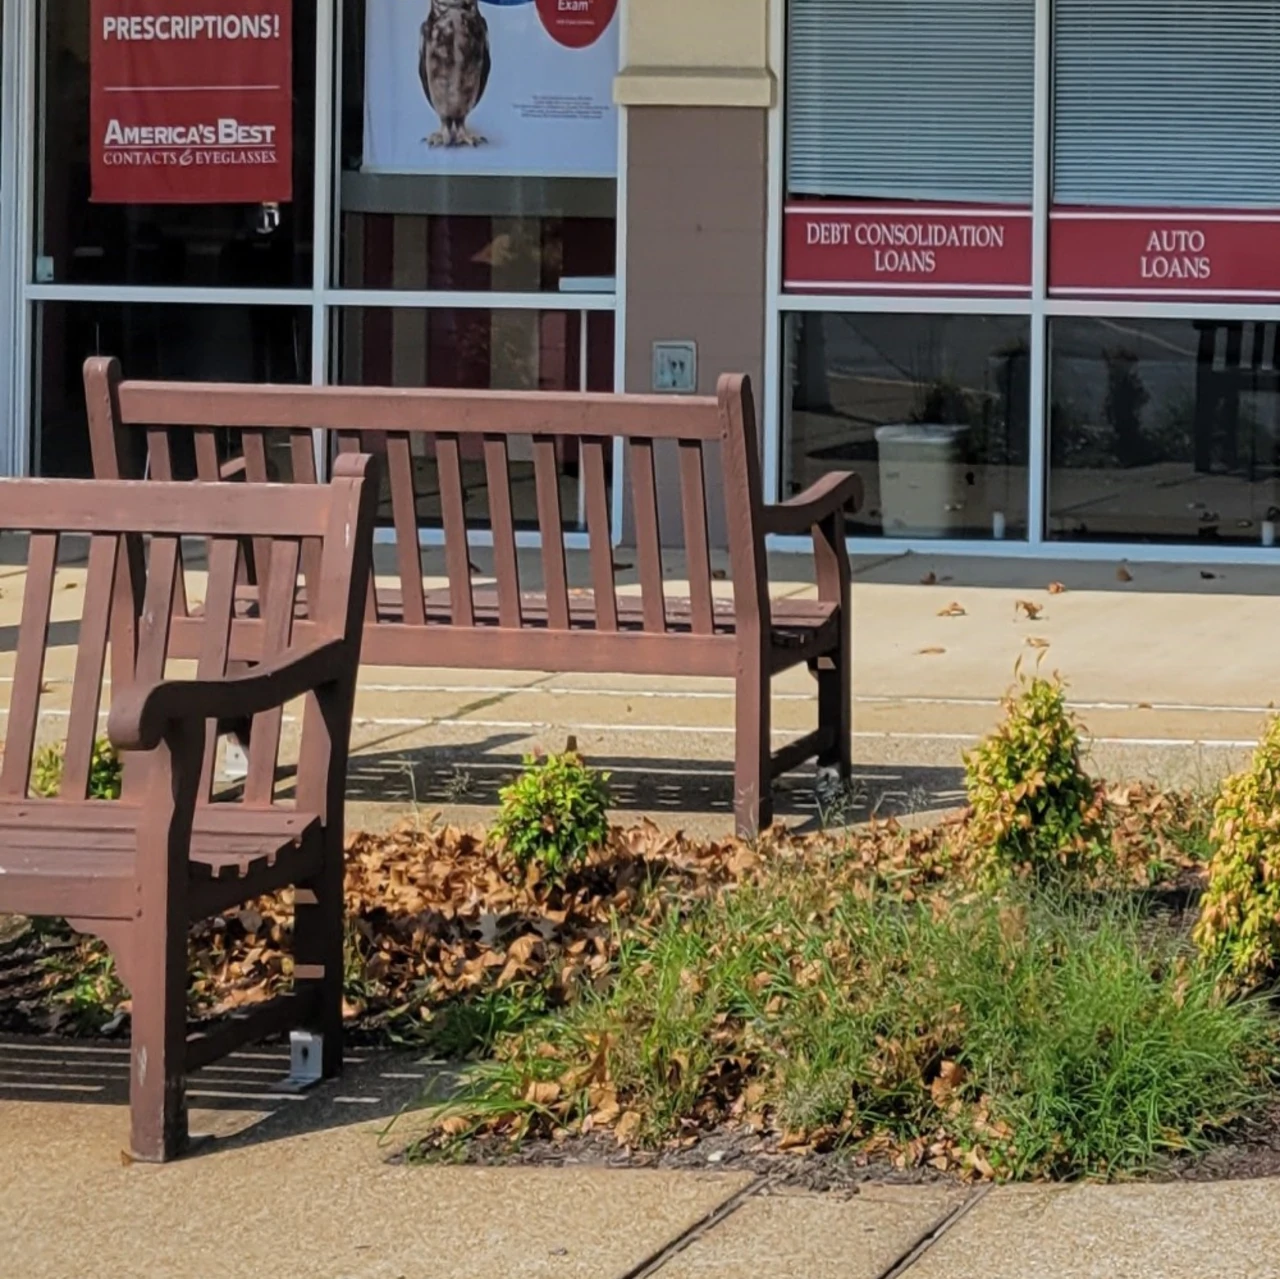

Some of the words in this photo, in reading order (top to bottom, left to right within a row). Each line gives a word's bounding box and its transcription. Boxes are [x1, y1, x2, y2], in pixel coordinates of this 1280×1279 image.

[102, 14, 280, 40] PRESCRIPTIONS!
[104, 119, 216, 146] AMERICA'S
[217, 118, 276, 144] BEST
[103, 151, 177, 165] CONTACTS
[195, 150, 276, 164] EYEGLASSES
[806, 223, 851, 246] DEBT
[854, 223, 1005, 248] CONSOLIDATION
[1146, 230, 1206, 253] AUTO
[874, 250, 937, 273] LOANS
[1140, 256, 1211, 280] LOANS
